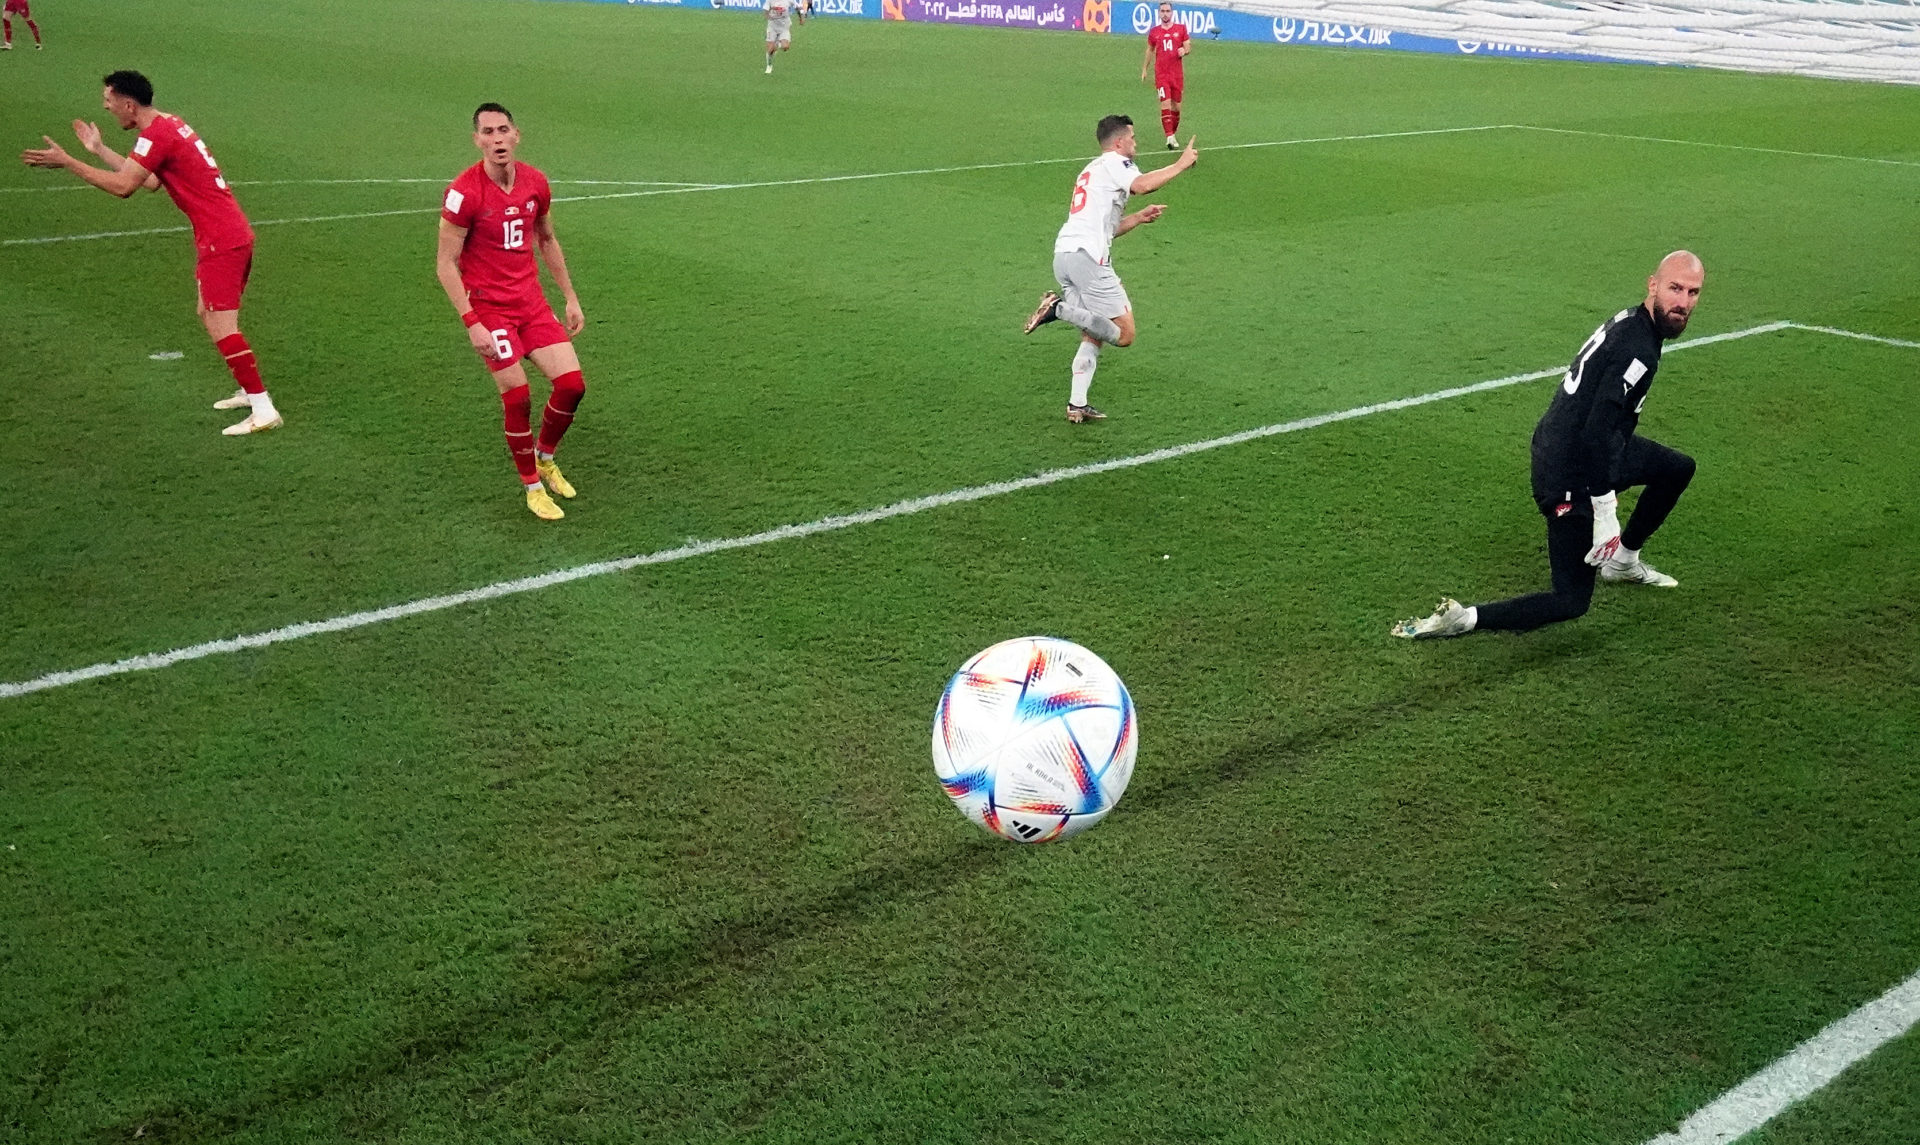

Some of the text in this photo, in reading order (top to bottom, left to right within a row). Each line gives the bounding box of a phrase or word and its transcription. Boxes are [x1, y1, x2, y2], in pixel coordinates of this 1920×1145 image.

[981, 4, 1004, 19] FIFA
[1005, 5, 1035, 23] العالم
[1163, 39, 1173, 51] 14
[503, 219, 524, 249] 16
